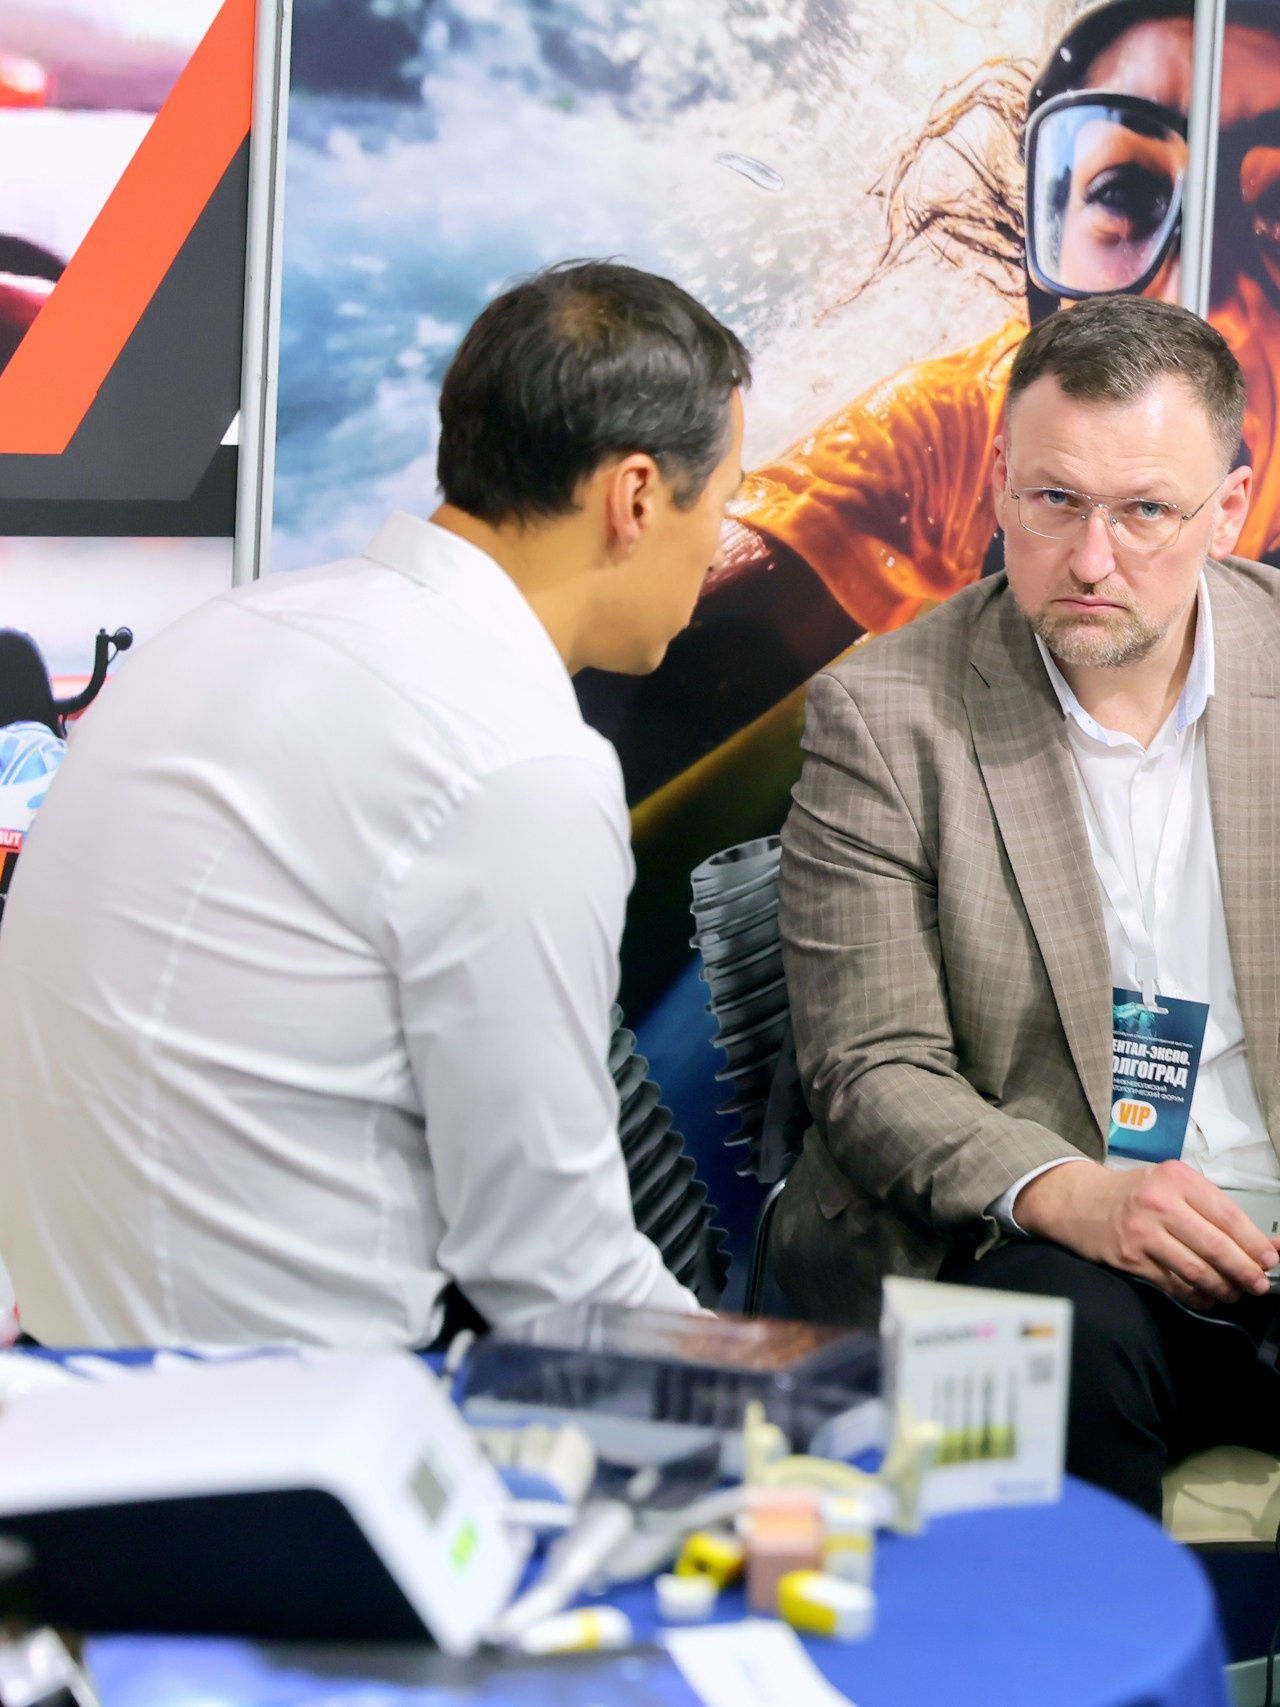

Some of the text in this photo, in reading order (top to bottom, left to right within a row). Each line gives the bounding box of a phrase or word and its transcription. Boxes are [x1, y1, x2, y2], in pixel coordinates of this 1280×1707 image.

[0, 831, 22, 848] UT
[1112, 1039, 1190, 1066] ЕНТАЛ-ЭКСПО.
[1112, 1055, 1188, 1089] ОЛГОГРАД
[1120, 1102, 1151, 1127] VIP
